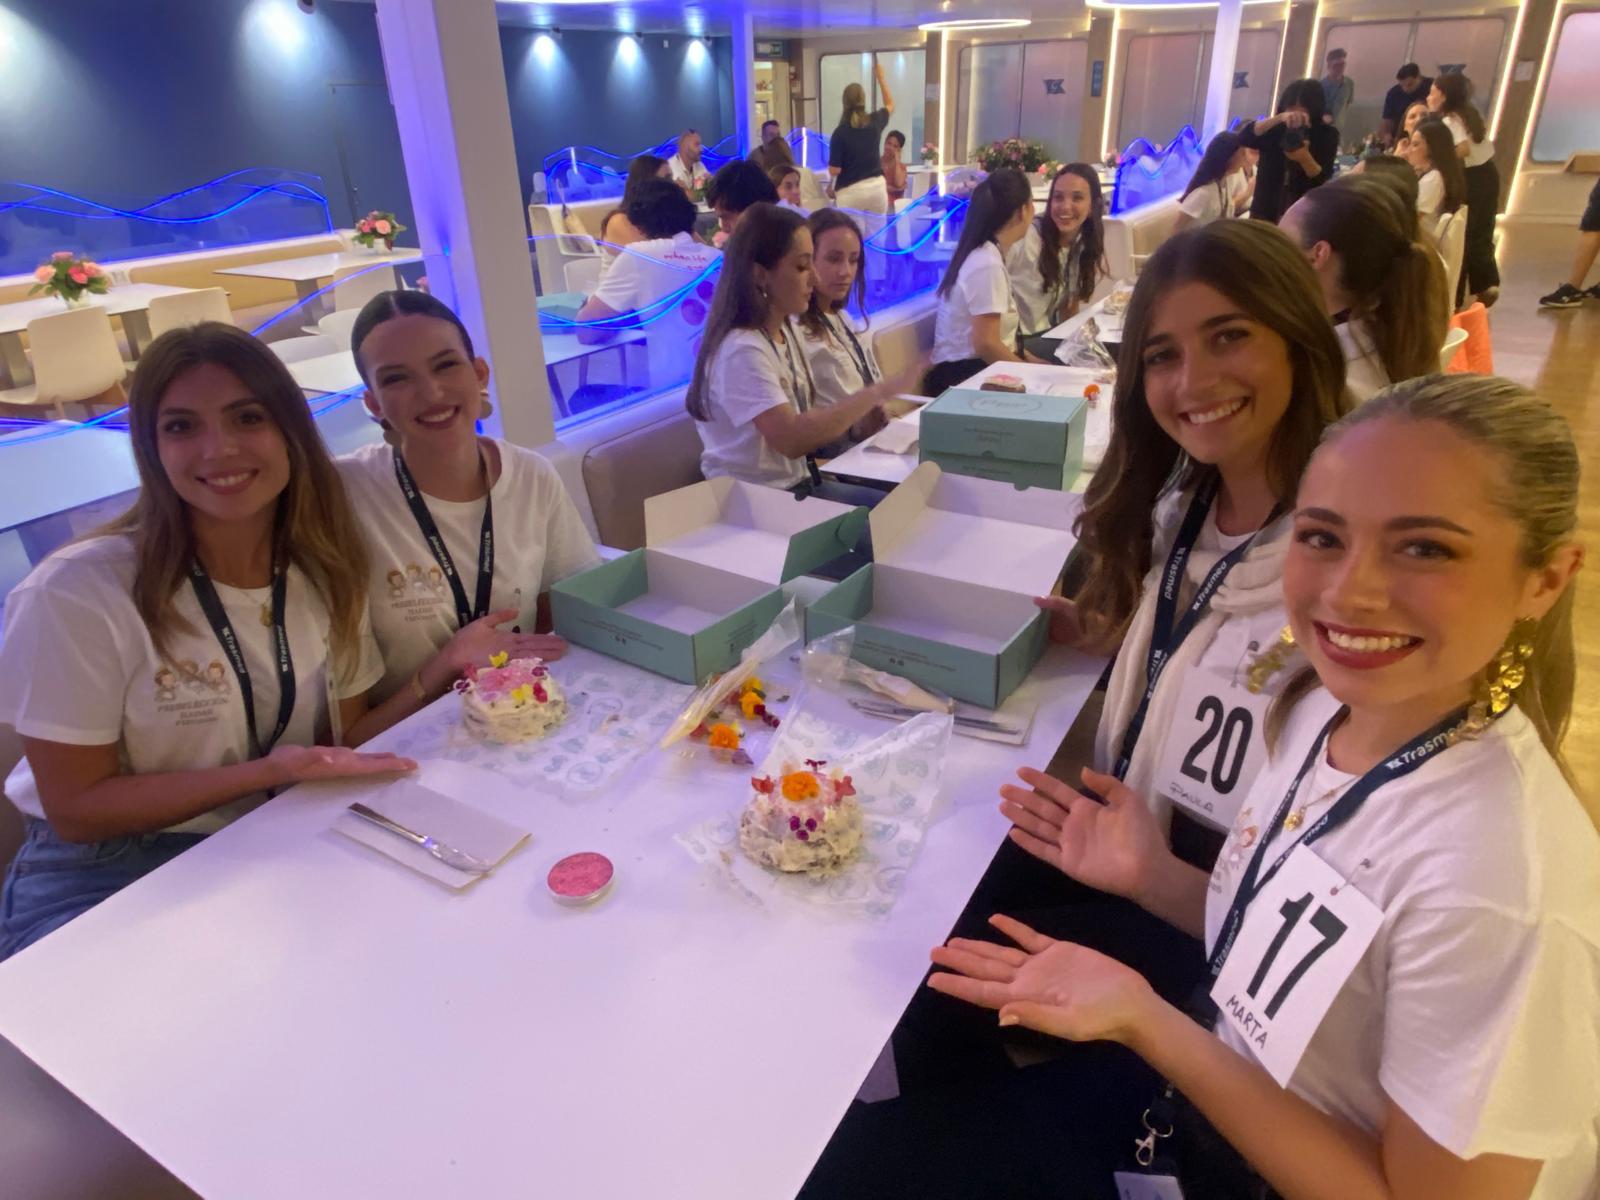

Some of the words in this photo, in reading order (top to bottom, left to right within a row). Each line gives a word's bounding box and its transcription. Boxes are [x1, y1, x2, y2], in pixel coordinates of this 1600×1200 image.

[1164, 552, 1186, 600] Trasmed
[1199, 561, 1228, 602] Trasmed
[1180, 695, 1253, 795] 20
[1400, 722, 1462, 764] Trasm
[1246, 891, 1349, 1020] 17
[1225, 994, 1270, 1049] MARTA
